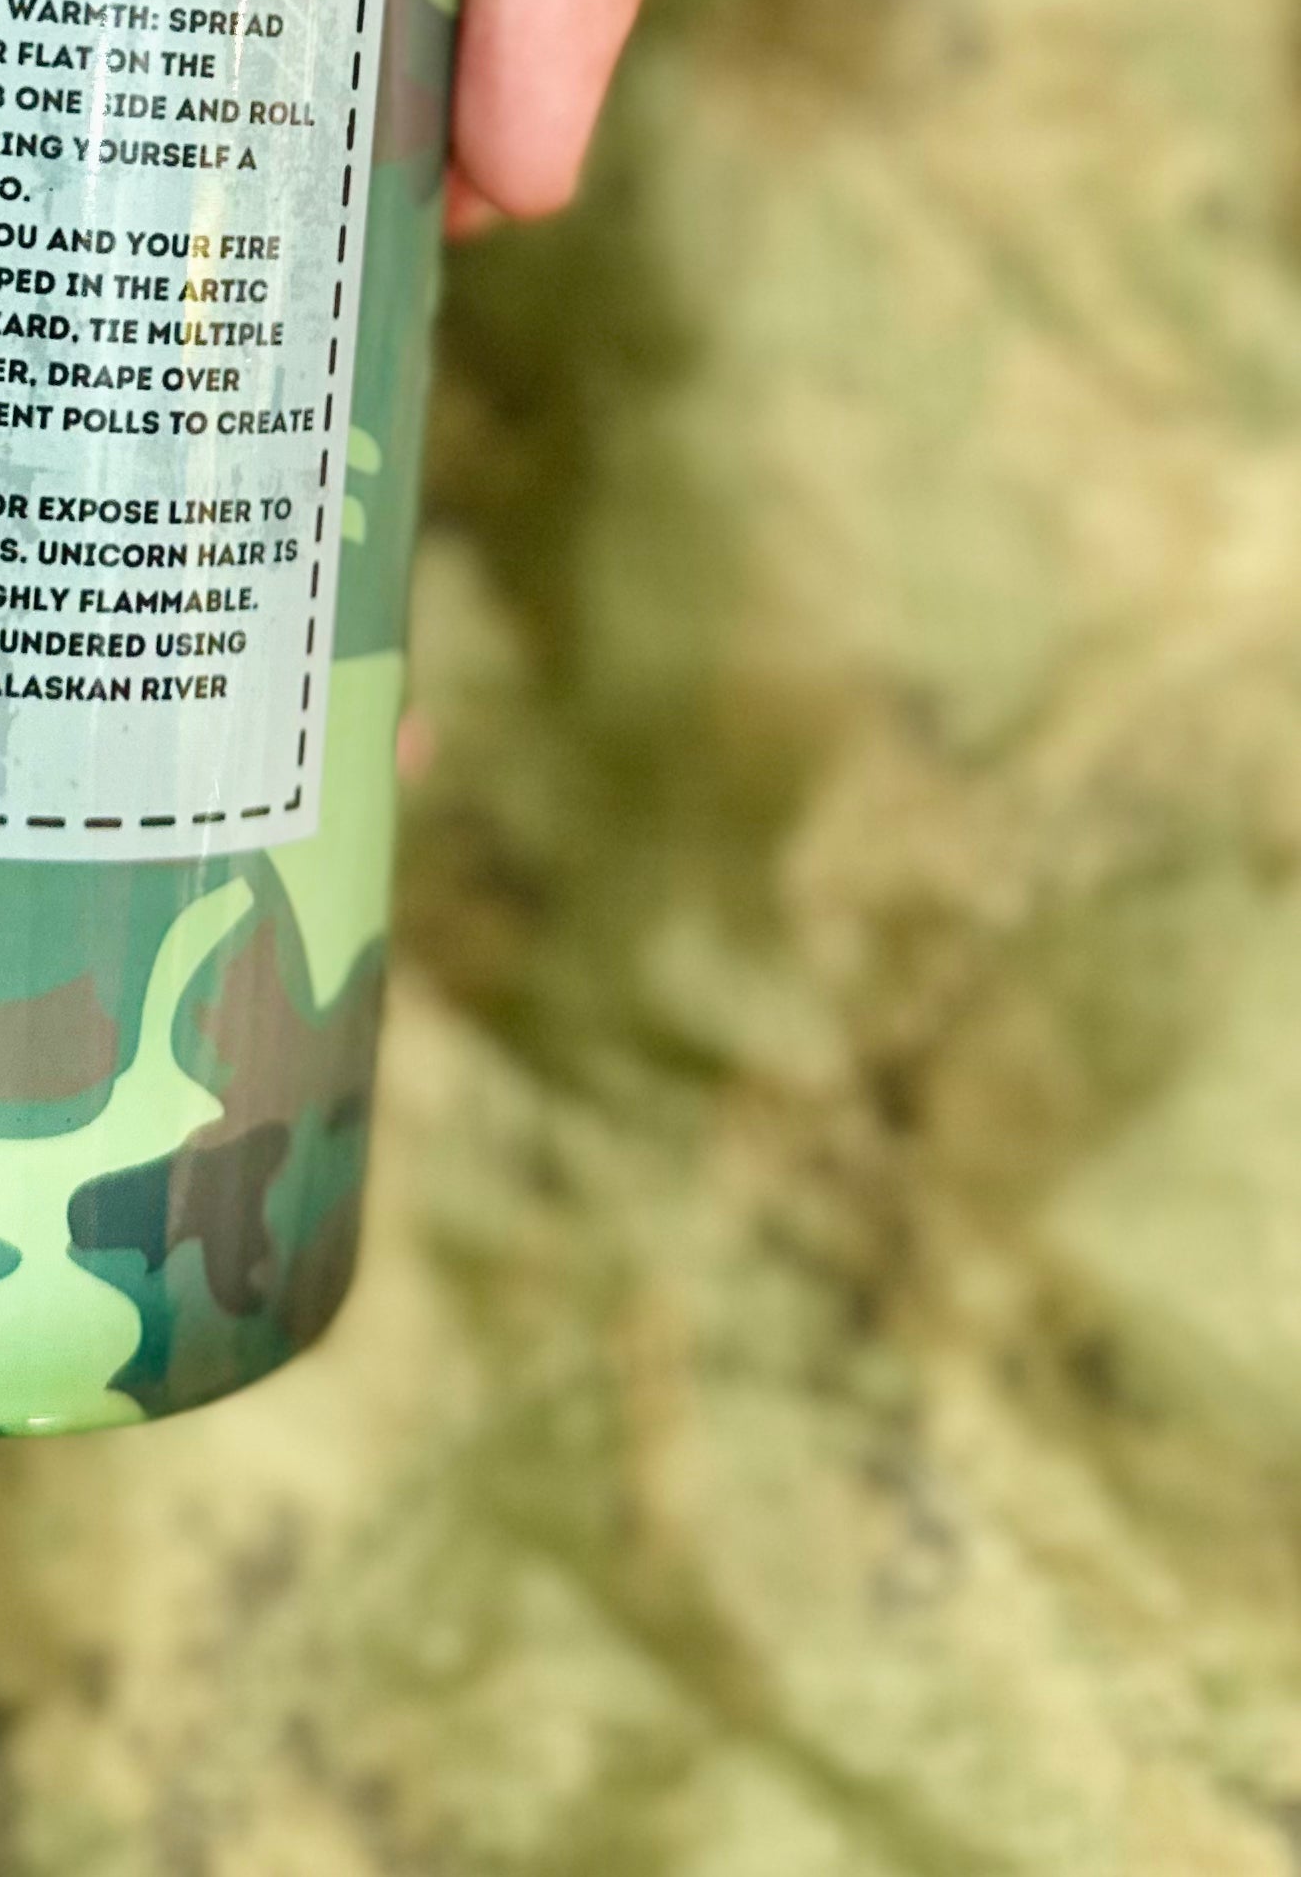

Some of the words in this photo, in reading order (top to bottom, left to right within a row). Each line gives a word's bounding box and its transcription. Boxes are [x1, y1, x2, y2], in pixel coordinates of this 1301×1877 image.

[17, 43, 89, 70] FLAT
[106, 48, 150, 73] ON
[161, 52, 215, 78] THE
[16, 87, 82, 114] ONE
[177, 98, 238, 123] AND
[250, 100, 314, 126] ROLL
[73, 138, 230, 170] YOURSELF
[237, 147, 257, 170] A
[46, 230, 116, 254] AND
[127, 233, 210, 259] YOUR
[219, 235, 280, 260] FIRE
[66, 273, 101, 297] IN
[114, 276, 168, 302] THE
[178, 278, 268, 303] ARTIC
[89, 318, 138, 344] TIE
[148, 321, 283, 346] MULTIPLE
[47, 362, 152, 389] DRAPE
[163, 367, 240, 392] OVER
[62, 408, 159, 435] POLLS
[170, 411, 208, 435] TO
[216, 408, 314, 435] CREATE
[38, 497, 159, 524] EXPOSE
[168, 499, 252, 524] LINER
[260, 498, 292, 521] TO
[38, 540, 188, 568] UNICORN
[197, 540, 264, 567] HAIR
[274, 539, 297, 562] IS
[79, 587, 258, 613] FLAMMABLE.
[155, 631, 246, 657] USING
[141, 675, 227, 701] RIVER
